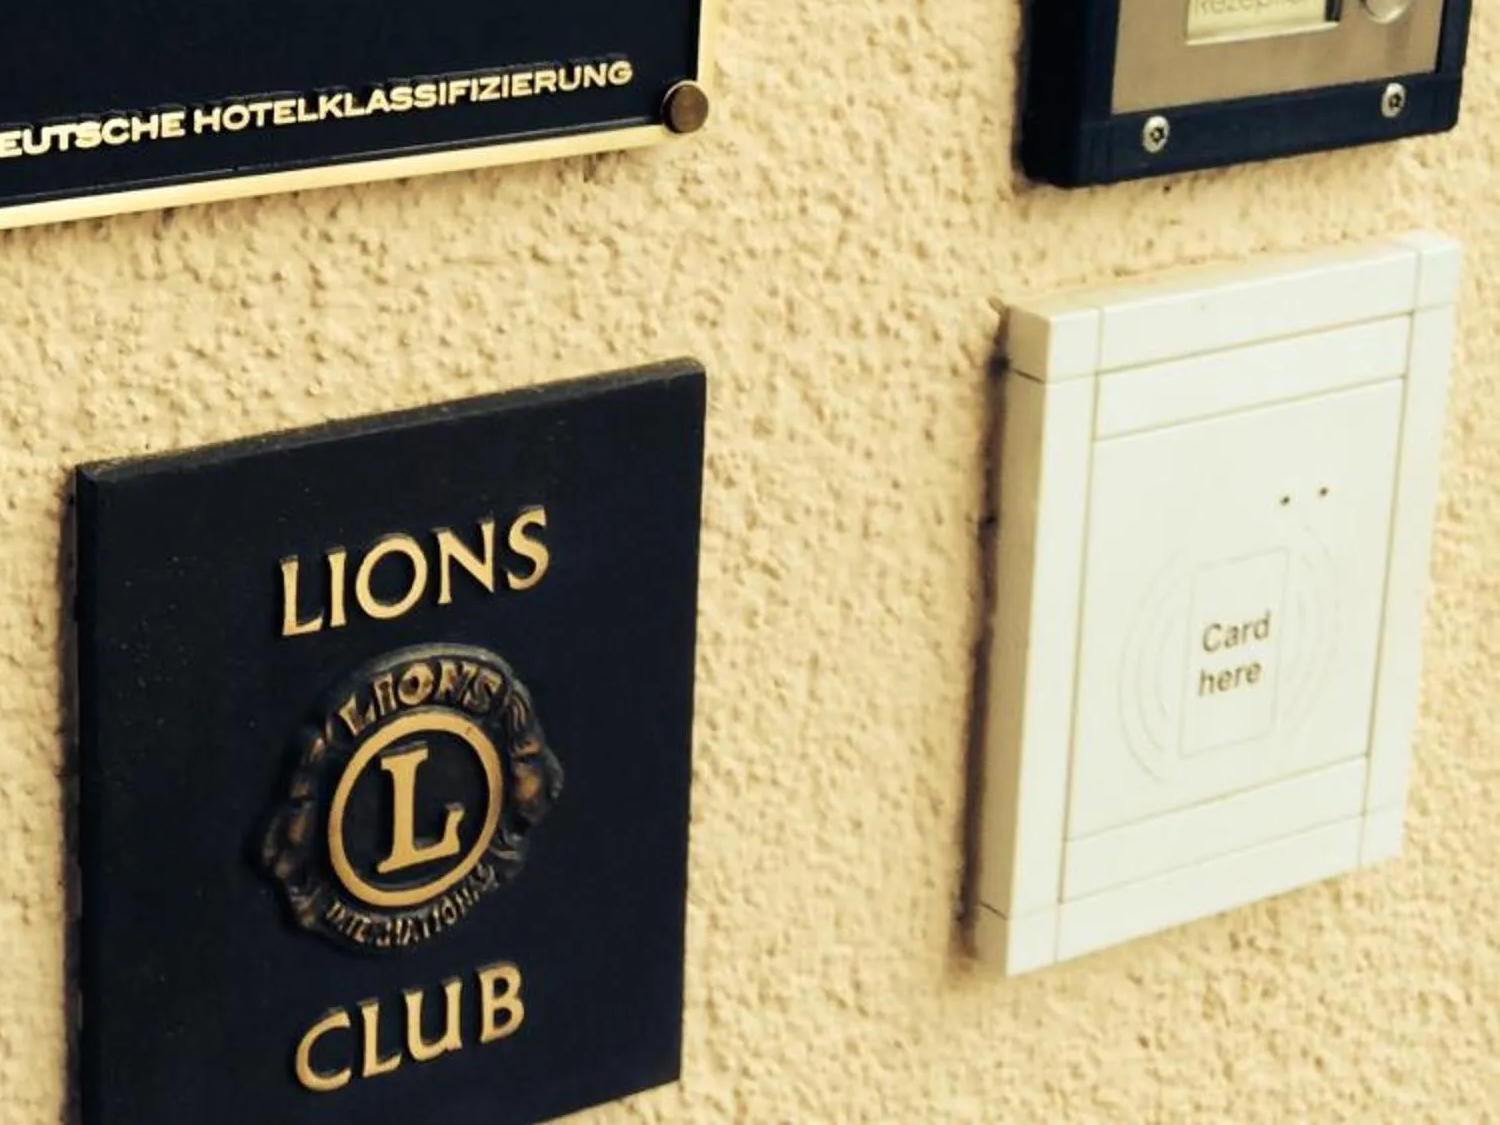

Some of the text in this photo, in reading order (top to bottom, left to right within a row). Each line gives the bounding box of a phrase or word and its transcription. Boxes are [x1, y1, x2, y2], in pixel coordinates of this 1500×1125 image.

[193, 61, 633, 134] HOTELKLASSIFIZIERUNG
[280, 505, 550, 638] LIONS
[1202, 608, 1271, 653] Card
[338, 658, 503, 736] LIONS
[1198, 662, 1262, 697] here
[376, 743, 463, 874] L
[295, 961, 526, 1093] CLUB
